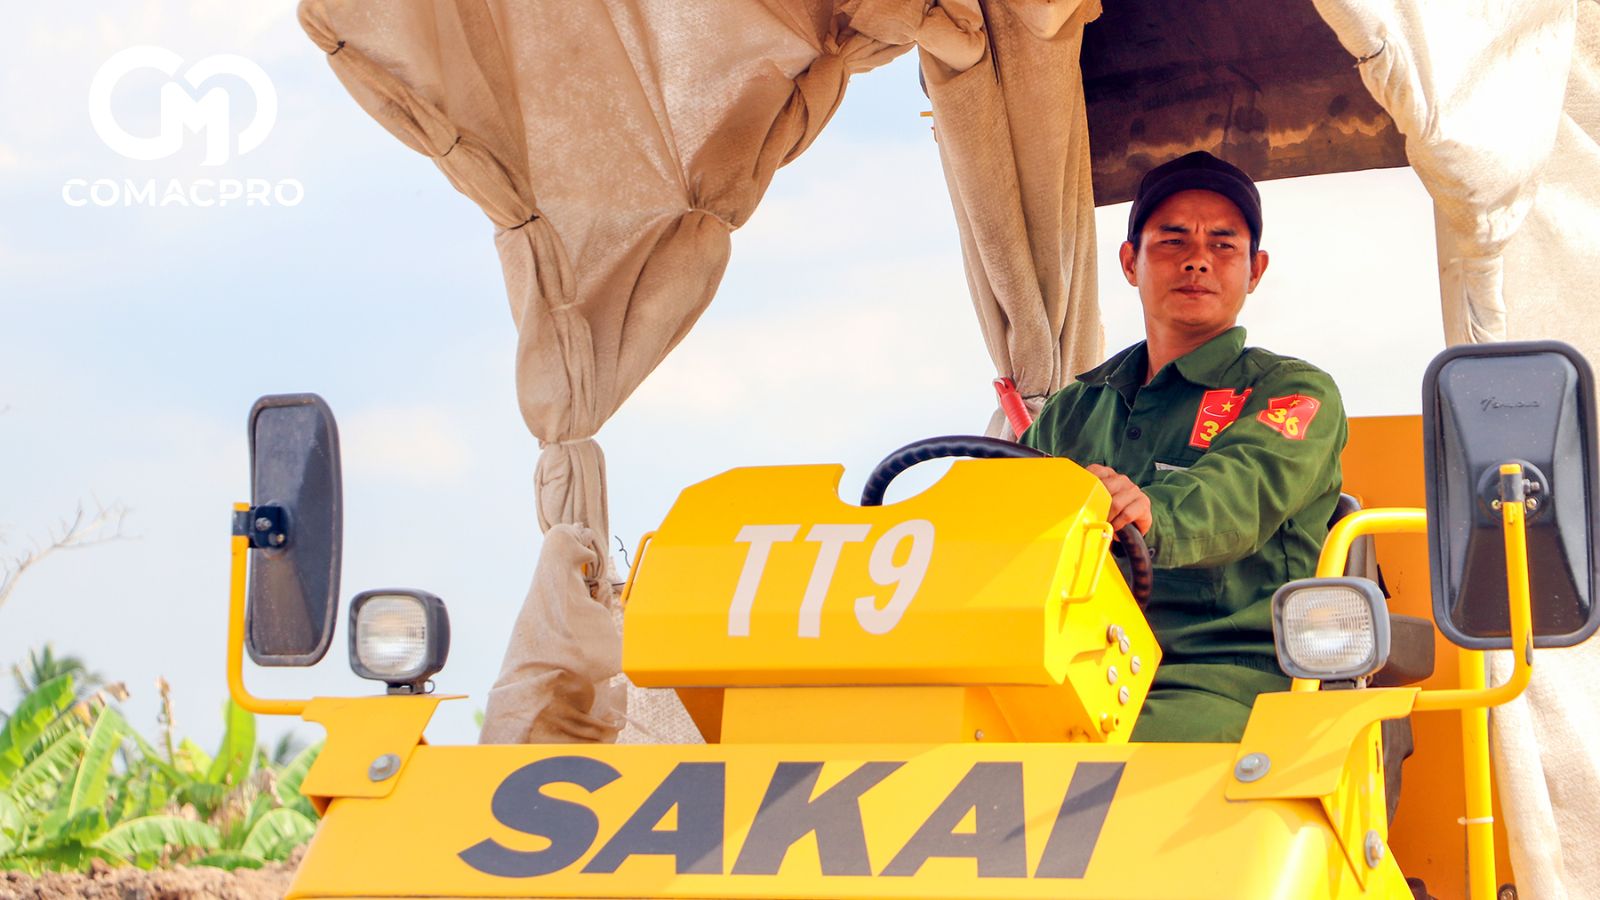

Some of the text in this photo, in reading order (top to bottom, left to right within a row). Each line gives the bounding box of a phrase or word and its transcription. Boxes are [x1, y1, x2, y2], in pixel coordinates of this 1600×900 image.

[1200, 420, 1233, 442] 3
[1267, 408, 1299, 436] 36
[727, 518, 936, 638] TT9
[457, 755, 1127, 879] SAKAI
